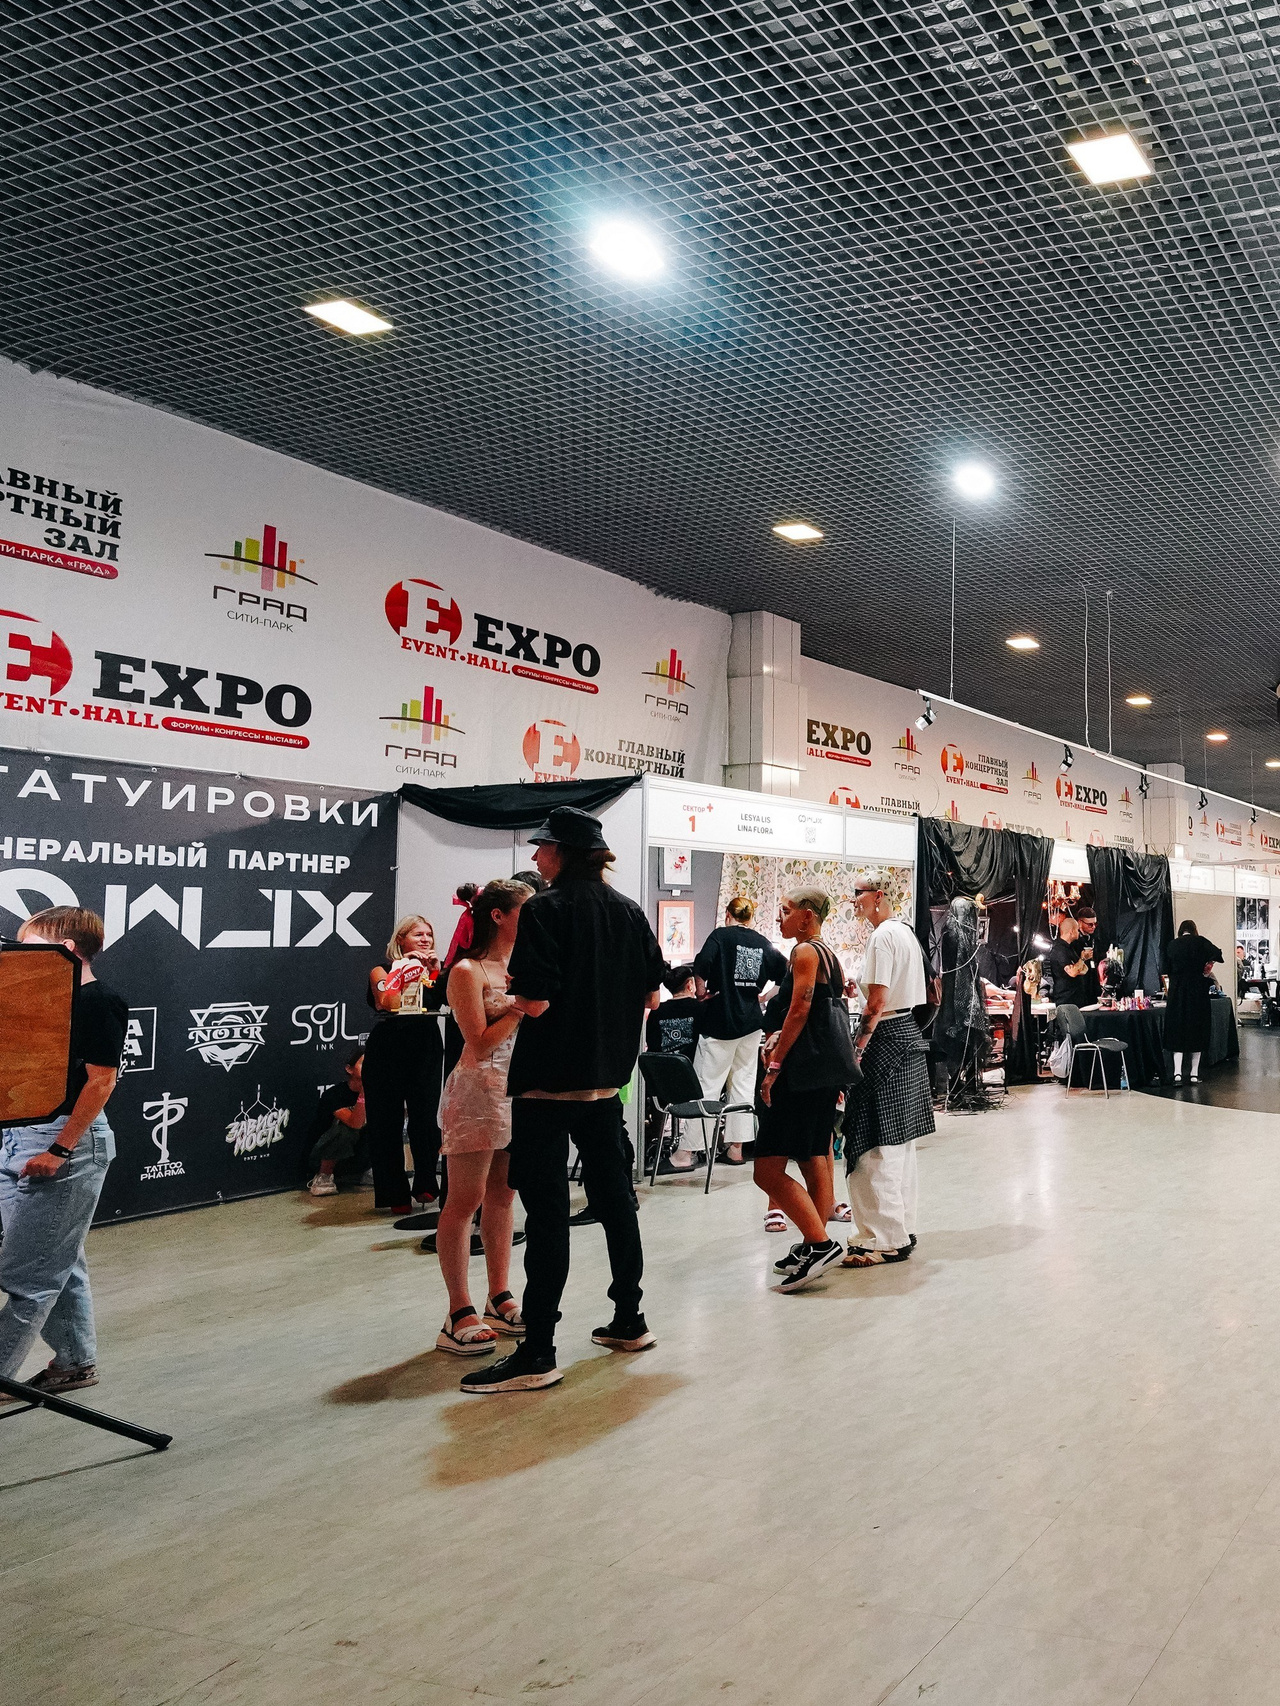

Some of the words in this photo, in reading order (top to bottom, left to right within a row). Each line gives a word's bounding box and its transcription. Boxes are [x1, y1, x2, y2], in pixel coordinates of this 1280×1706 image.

[0, 467, 123, 516] ВНЫЙ
[43, 527, 119, 562] ЗАЛ
[67, 560, 111, 576] «ГРАД»
[213, 585, 308, 622] ГРАД
[226, 610, 293, 633] СИТИ-ПАРК
[472, 612, 601, 678] EXPO
[92, 650, 313, 728] EXPO
[644, 693, 689, 716] ГРАД
[170, 720, 210, 733] ФОРУМЫ
[214, 727, 261, 740] КОНГРЕССЫ
[265, 734, 303, 746] ВЫСТАВКИ
[807, 718, 872, 756] EXPO
[384, 744, 457, 768] ГРАД
[584, 748, 685, 779] КОНЦЕРТНЫЙ
[618, 739, 686, 765] ГЛАВНЫЙ
[978, 754, 1009, 770] ГЛАВНЫЙ
[395, 765, 447, 779] СИТИ-ПАРК
[965, 761, 1009, 778] КОНЦЕРТНЫЙ
[995, 777, 1009, 787] ЗАЛ
[0, 766, 379, 828] АТУИРОВКИ
[1075, 785, 1108, 807] EXPO
[682, 804, 706, 814] СЕКТОР
[689, 815, 696, 833] 1
[737, 824, 753, 833] LINA
[753, 825, 773, 835] FLORA
[228, 849, 351, 875] ПАРТНЕР
[188, 1026, 264, 1044] NOIR
[140, 1168, 186, 1182] PHARMA
[144, 1161, 183, 1174] TATTOO
